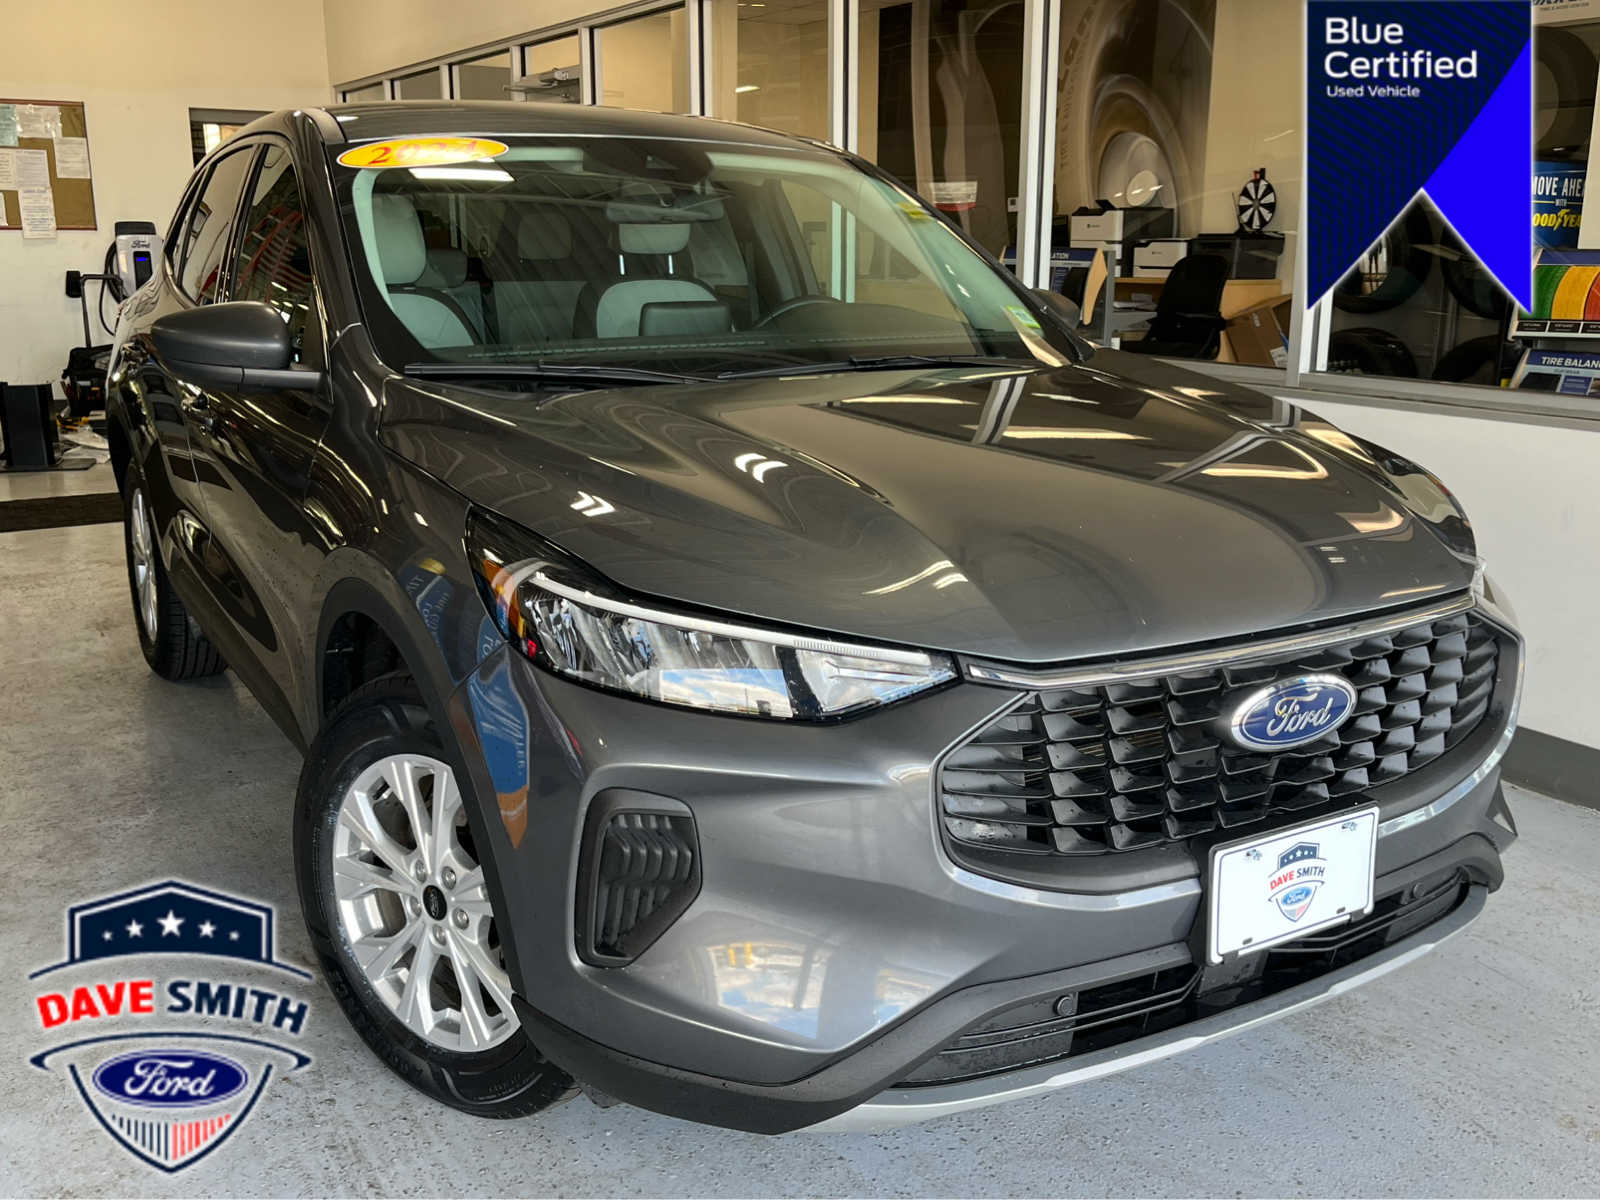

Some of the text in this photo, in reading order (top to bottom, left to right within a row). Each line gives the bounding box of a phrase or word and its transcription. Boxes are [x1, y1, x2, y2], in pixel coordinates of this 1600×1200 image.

[1562, 177, 1584, 197] AHE
[1541, 356, 1600, 369] TIRE BALAN
[1266, 692, 1334, 737] Ford
[1270, 866, 1325, 890] DAVE SMITH
